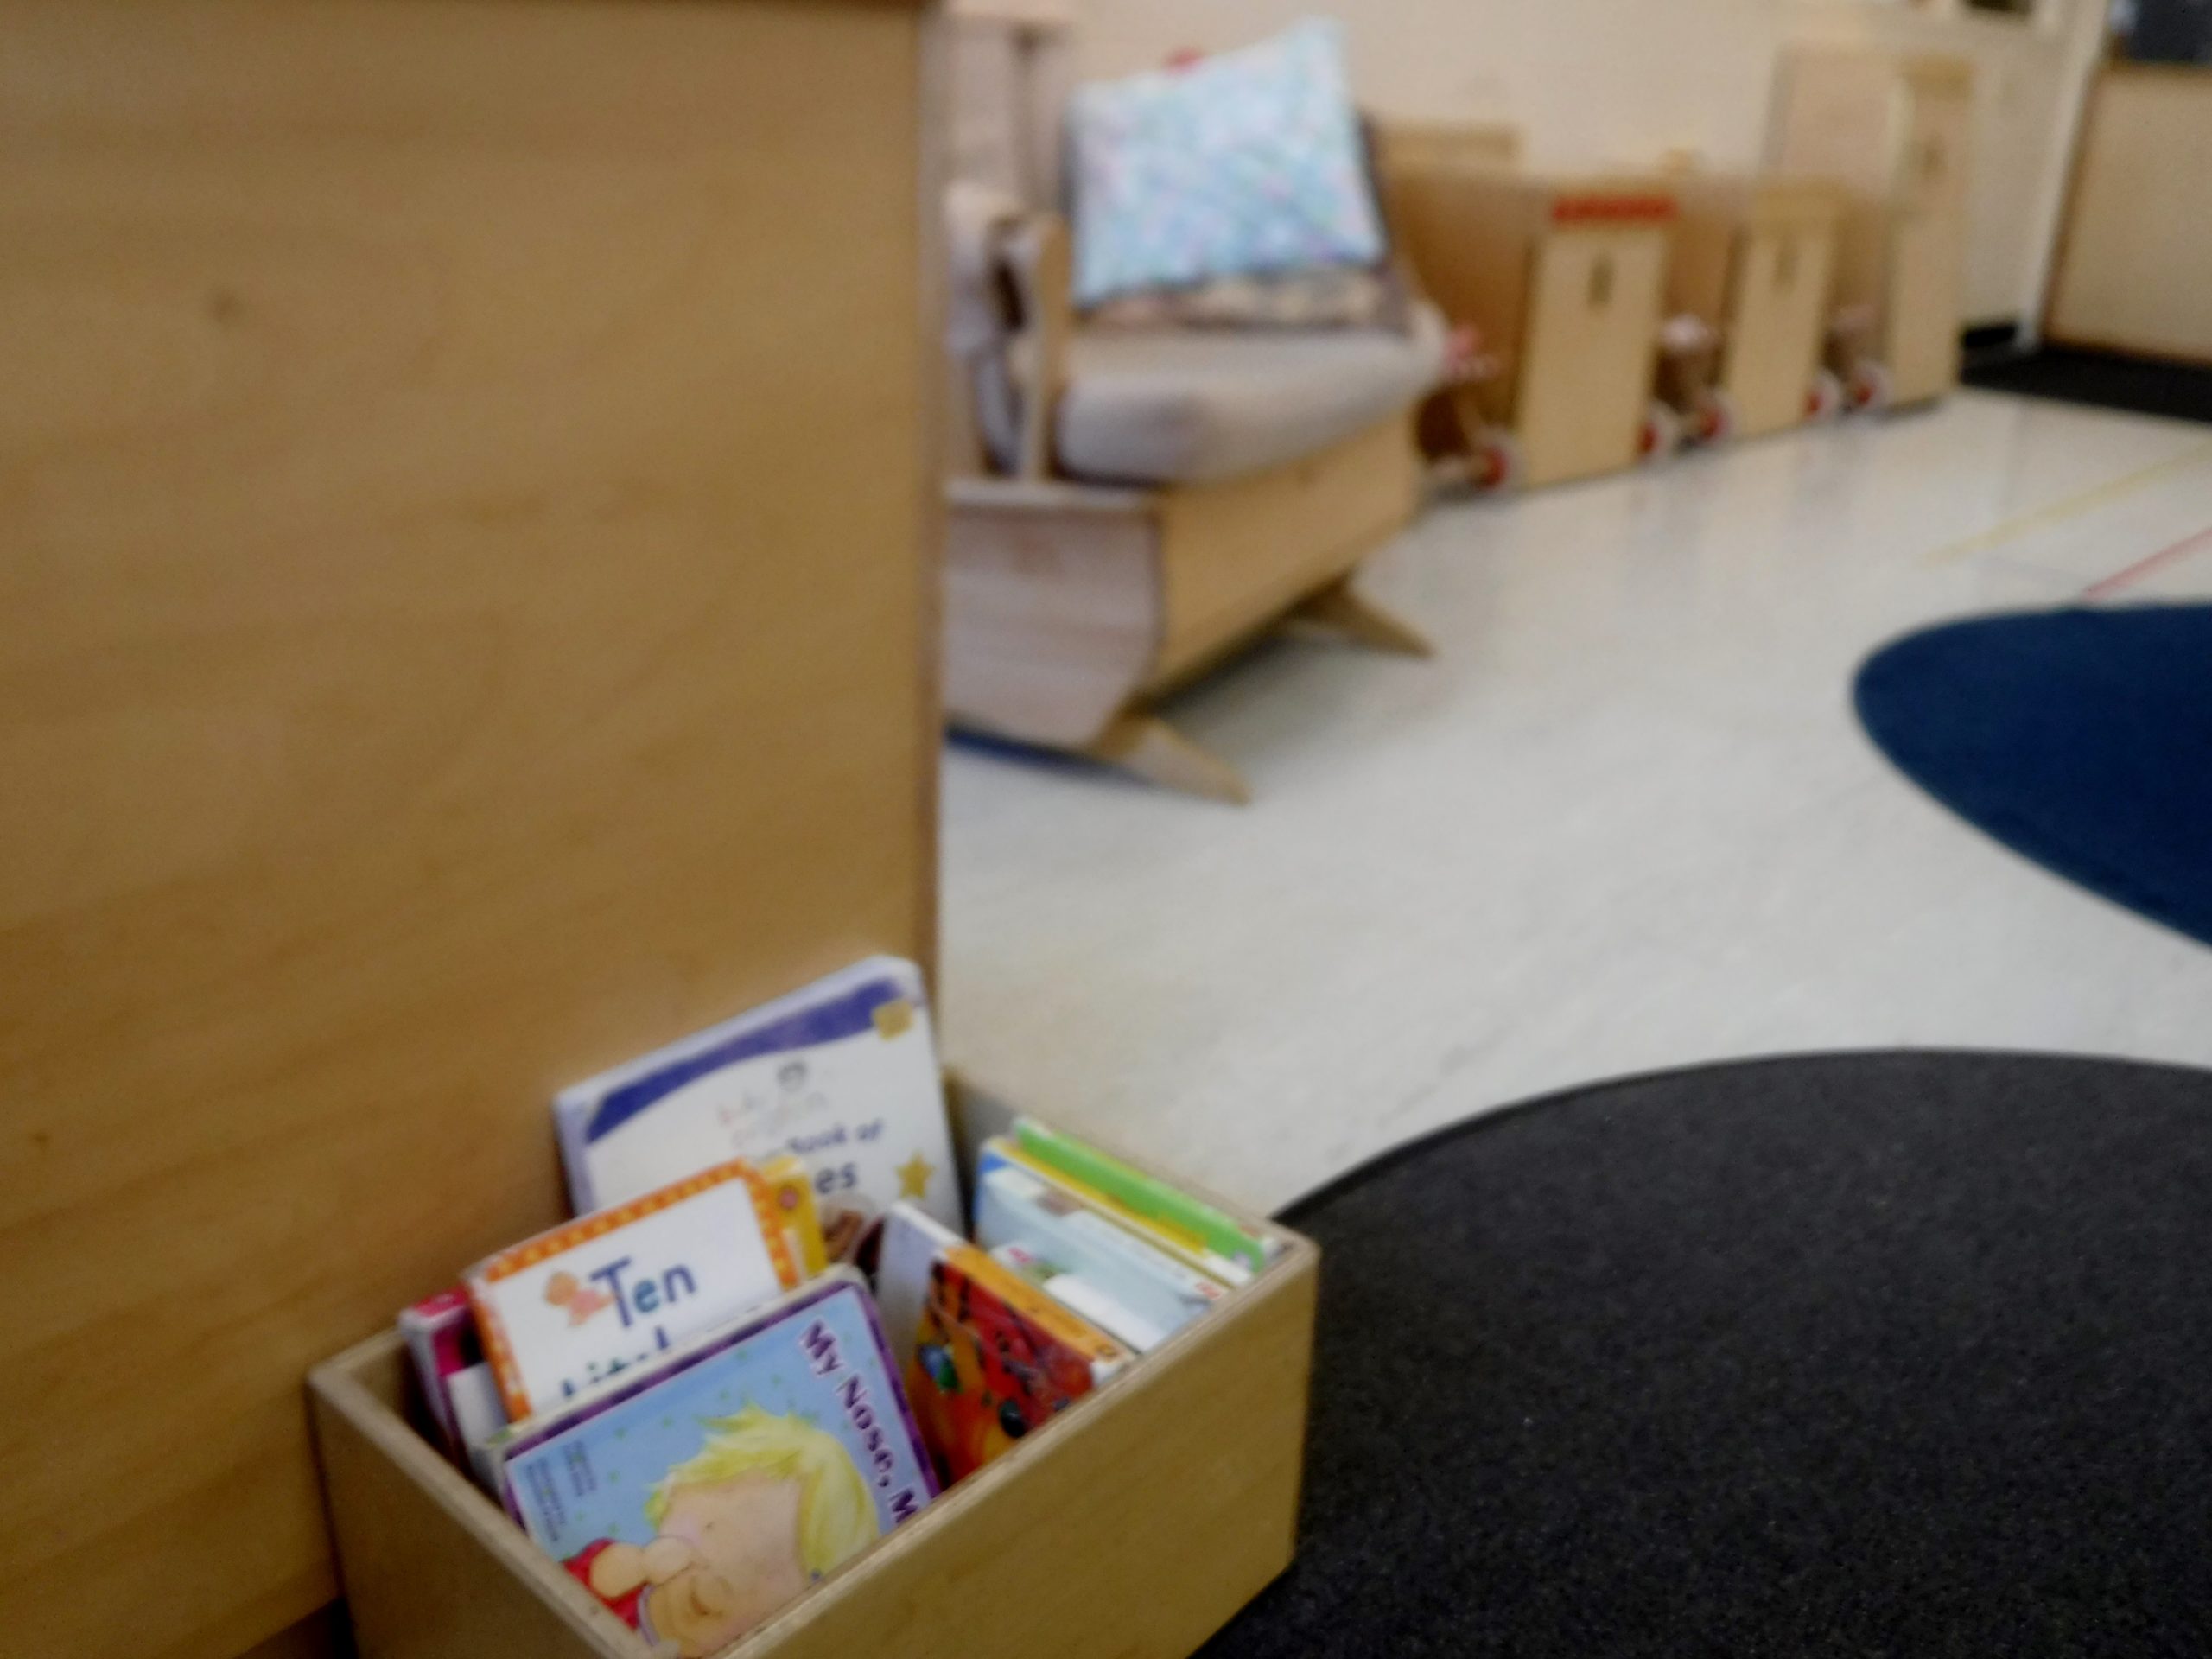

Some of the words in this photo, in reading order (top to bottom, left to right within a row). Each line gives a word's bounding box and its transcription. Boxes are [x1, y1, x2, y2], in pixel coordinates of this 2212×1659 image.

[588, 1255, 697, 1328] Ten
[800, 1319, 843, 1376] My
[836, 1372, 893, 1488] Nose,
